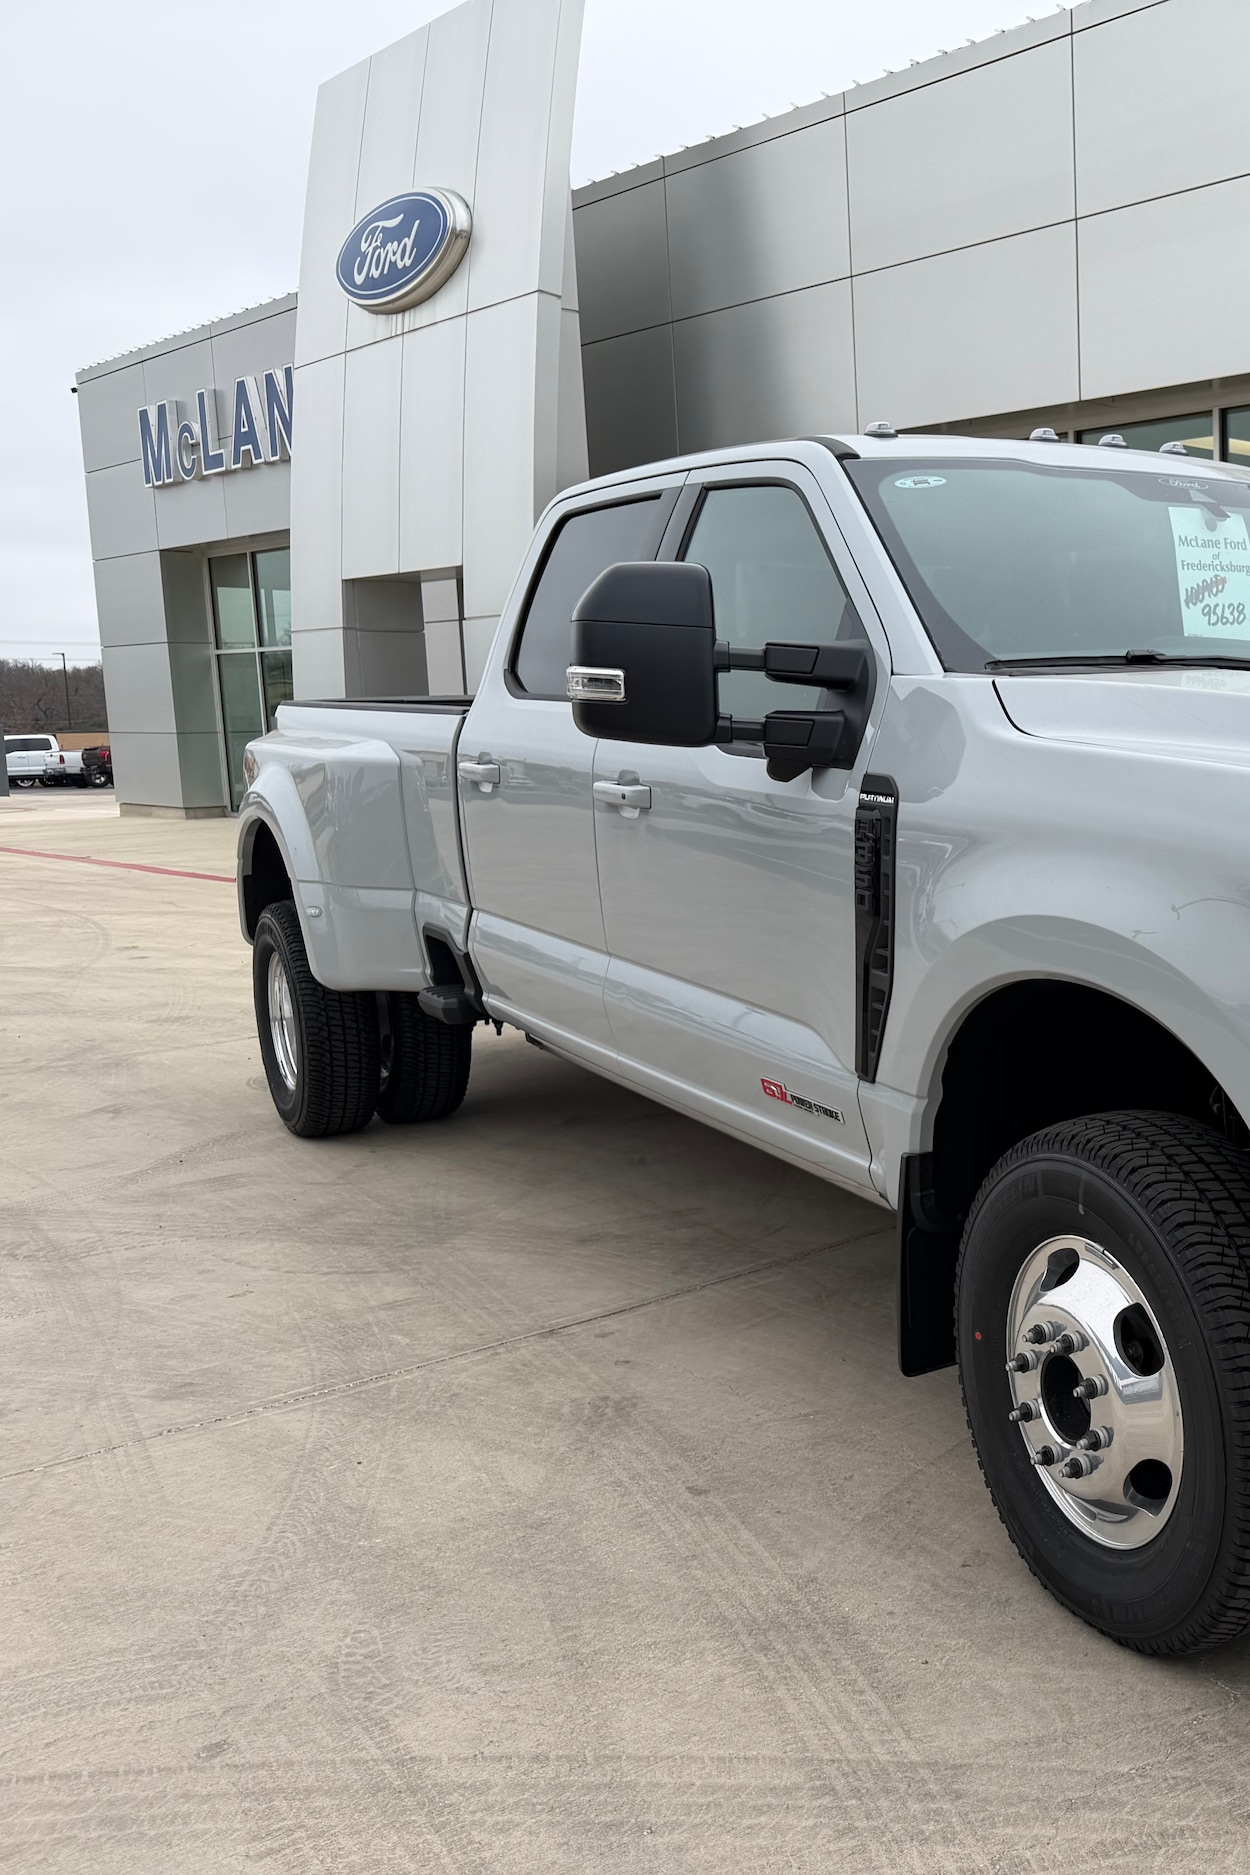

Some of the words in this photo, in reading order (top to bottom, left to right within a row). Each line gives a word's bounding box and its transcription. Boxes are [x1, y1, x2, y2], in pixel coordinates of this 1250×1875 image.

[354, 213, 420, 285] Ford
[1178, 535, 1221, 549] McLane
[1223, 537, 1248, 551] Ford
[1211, 552, 1220, 561] of
[1201, 602, 1246, 626] 95638
